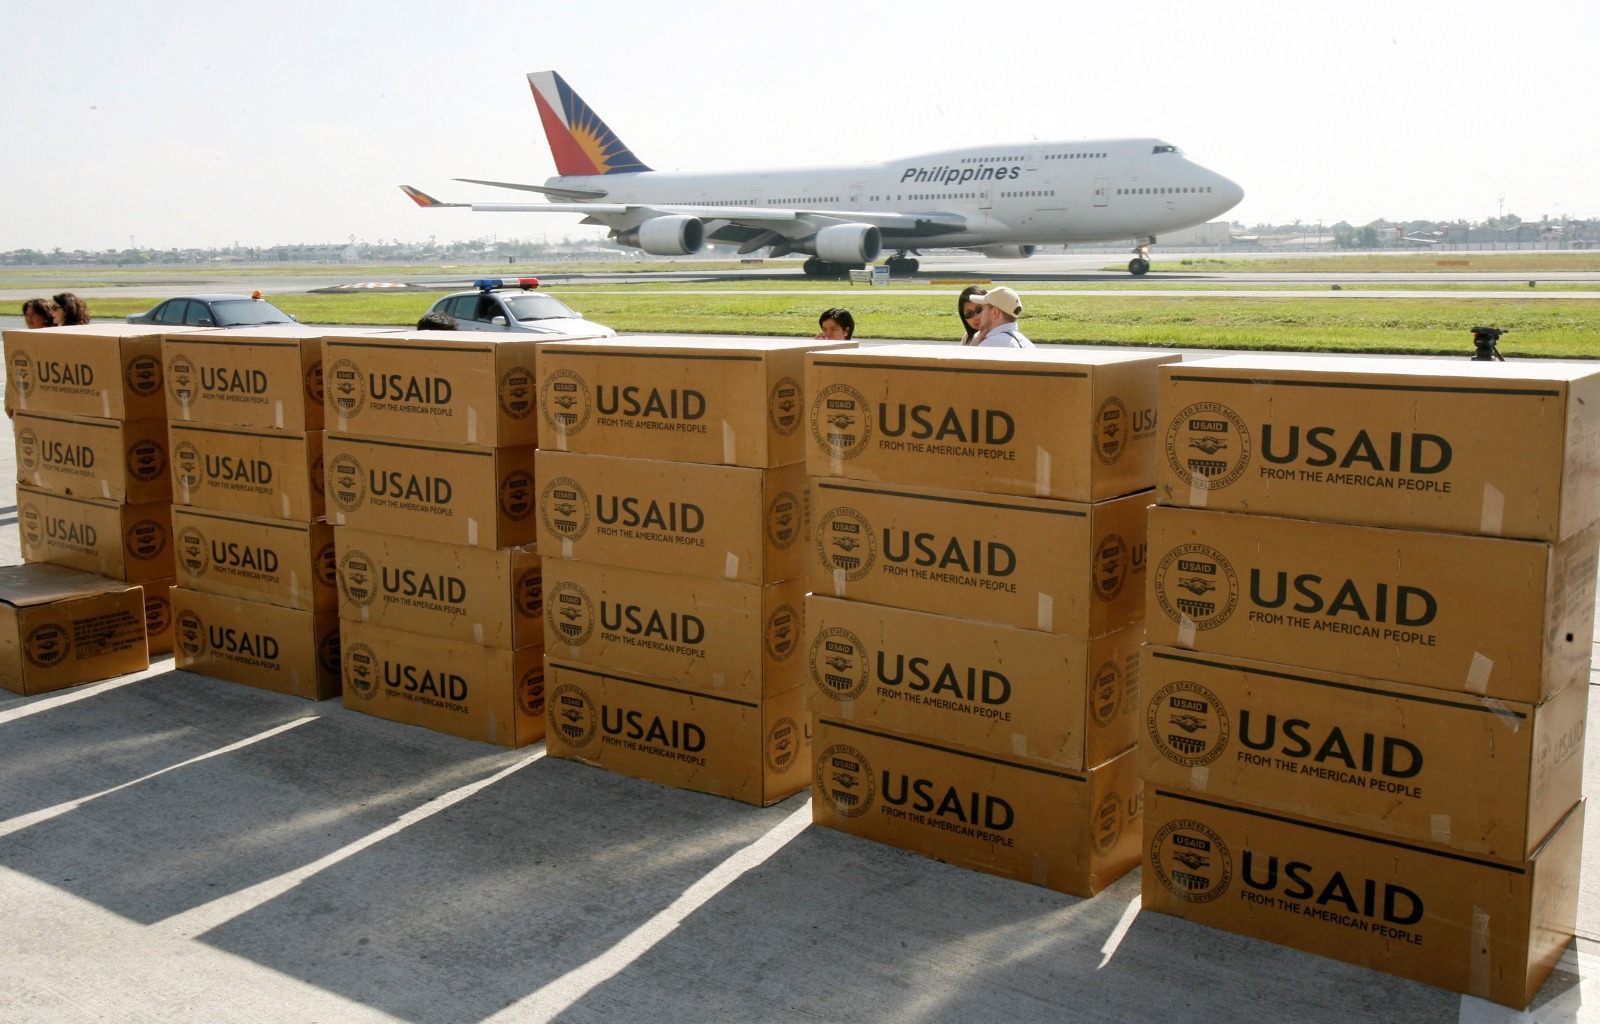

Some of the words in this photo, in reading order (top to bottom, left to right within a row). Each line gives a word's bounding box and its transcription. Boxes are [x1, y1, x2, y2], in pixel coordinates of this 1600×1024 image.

[900, 164, 1021, 186] Philippines
[37, 361, 93, 386] USAID
[200, 367, 267, 394] USAID
[369, 373, 452, 404] USAID
[202, 392, 215, 400] FROM
[225, 394, 249, 403] AMERICAN
[250, 396, 269, 404] PEOPLE
[370, 402, 386, 410] FROM
[387, 403, 398, 411] THE
[399, 405, 428, 414] AMERICAN
[430, 407, 453, 416] PEOPLE
[596, 385, 706, 420] USAID
[829, 400, 851, 409] USAID
[597, 417, 618, 427] FROM
[619, 419, 634, 428] THE
[635, 420, 674, 431] AMERICAN
[676, 423, 707, 433] PEOPLE
[879, 403, 1015, 445] USAID
[1171, 407, 1193, 430] UNITED
[1194, 404, 1221, 412] STATES
[1222, 408, 1246, 434] AGENCY
[1192, 421, 1223, 431] USAID
[42, 440, 94, 468] USAID
[879, 439, 904, 451] FROM
[906, 442, 924, 452] THE
[926, 444, 974, 457] AMERICAN
[977, 448, 1015, 461] PEOPLE
[1261, 424, 1452, 474] USAID
[205, 454, 272, 484] USAID
[1210, 449, 1249, 487] DEVELOPMENT
[1260, 467, 1295, 480] FROM
[1299, 470, 1323, 482] THE
[1326, 473, 1393, 488] AMERICAN
[1398, 478, 1451, 493] PEOPLE
[207, 479, 220, 488] FROM
[220, 481, 230, 489] THE
[230, 483, 254, 492] AMERICAN
[255, 486, 273, 495] PEOPLE
[370, 469, 452, 504] USAID
[555, 491, 574, 499] USAID
[370, 497, 386, 506] FROM
[387, 500, 398, 508] THE
[399, 502, 428, 513] AMERICAN
[430, 506, 453, 516] PEOPLE
[596, 494, 704, 533] USAID
[45, 516, 97, 546] USAID
[597, 526, 617, 536] FROM
[619, 529, 633, 538] THE
[634, 531, 673, 543] AMERICAN
[675, 535, 705, 547] PEOPLE
[834, 523, 856, 532] USAID
[211, 539, 278, 572] USAID
[883, 528, 1016, 577] USAID
[1160, 548, 1182, 569] UNITED
[1183, 545, 1210, 554] STATES
[1211, 551, 1234, 577] AGENCY
[1181, 561, 1211, 573] USAID
[213, 565, 226, 573] FROM
[227, 567, 236, 575] THE
[237, 569, 261, 580] AMERICAN
[261, 574, 279, 583] PEOPLE
[382, 566, 466, 603] USAID
[883, 564, 908, 576] FROM
[910, 568, 927, 579] THE
[929, 572, 977, 587] AMERICAN
[979, 579, 1016, 593] PEOPLE
[383, 594, 399, 604] FROM
[400, 597, 411, 606] THE
[412, 600, 442, 611] AMERICAN
[443, 605, 467, 616] PEOPLE
[561, 595, 579, 604] USAID
[1198, 592, 1236, 628] DEVELOPMENT
[1250, 568, 1437, 627] USAID
[600, 601, 704, 644] USAID
[1249, 610, 1283, 625] FROM
[1286, 615, 1310, 628] THE
[1313, 620, 1379, 638] AMERICAN
[1383, 629, 1436, 646] PEOPLE
[209, 625, 279, 660] USAID
[601, 632, 620, 643] FROM
[622, 636, 635, 646] THE
[637, 639, 674, 653] AMERICAN
[676, 646, 705, 658] PEOPLE
[828, 642, 850, 653] USAID
[384, 661, 467, 701] USAID
[877, 651, 1011, 705] USAID
[385, 688, 401, 698] FROM
[401, 692, 413, 701] THE
[414, 695, 444, 708] AMERICAN
[445, 702, 469, 714] PEOPLE
[563, 697, 580, 706] USAID
[877, 686, 901, 700] FROM
[903, 692, 921, 704] THE
[923, 696, 970, 714] AMERICAN
[973, 706, 1011, 722] PEOPLE
[1152, 685, 1174, 705] UNITED
[1175, 683, 1202, 693] STATES
[1202, 690, 1225, 716] AGENCY
[1173, 698, 1203, 711] USAID
[601, 704, 705, 752] USAID
[1149, 717, 1189, 764] INTERNATIONAL
[1189, 731, 1227, 765] DEVELOPMENT
[601, 735, 621, 747] FROM
[623, 740, 637, 750] THE
[638, 744, 675, 759] AMERICAN
[677, 752, 706, 766] PEOPLE
[1239, 710, 1423, 778] USAID
[834, 759, 856, 771] USAID
[1237, 751, 1271, 767] FROM
[1274, 758, 1298, 773] THE
[1300, 765, 1366, 787] AMERICAN
[1369, 778, 1421, 799] PEOPLE
[882, 770, 1014, 830] USAID
[881, 805, 906, 819] FROM
[908, 812, 925, 824] THE
[926, 817, 974, 837] AMERICAN
[976, 830, 1013, 848] PEOPLE
[1156, 822, 1177, 841] UNITED
[1178, 821, 1204, 831] STATES
[1205, 829, 1228, 855] AGENCY
[1176, 836, 1206, 850] USAID
[1193, 870, 1230, 901] DEVELOPMENT
[1242, 850, 1423, 925] USAID
[1241, 889, 1274, 907] FROM
[1277, 899, 1300, 914] THE
[1303, 906, 1368, 931] AMERICAN
[1371, 923, 1422, 945] PEOPLE
